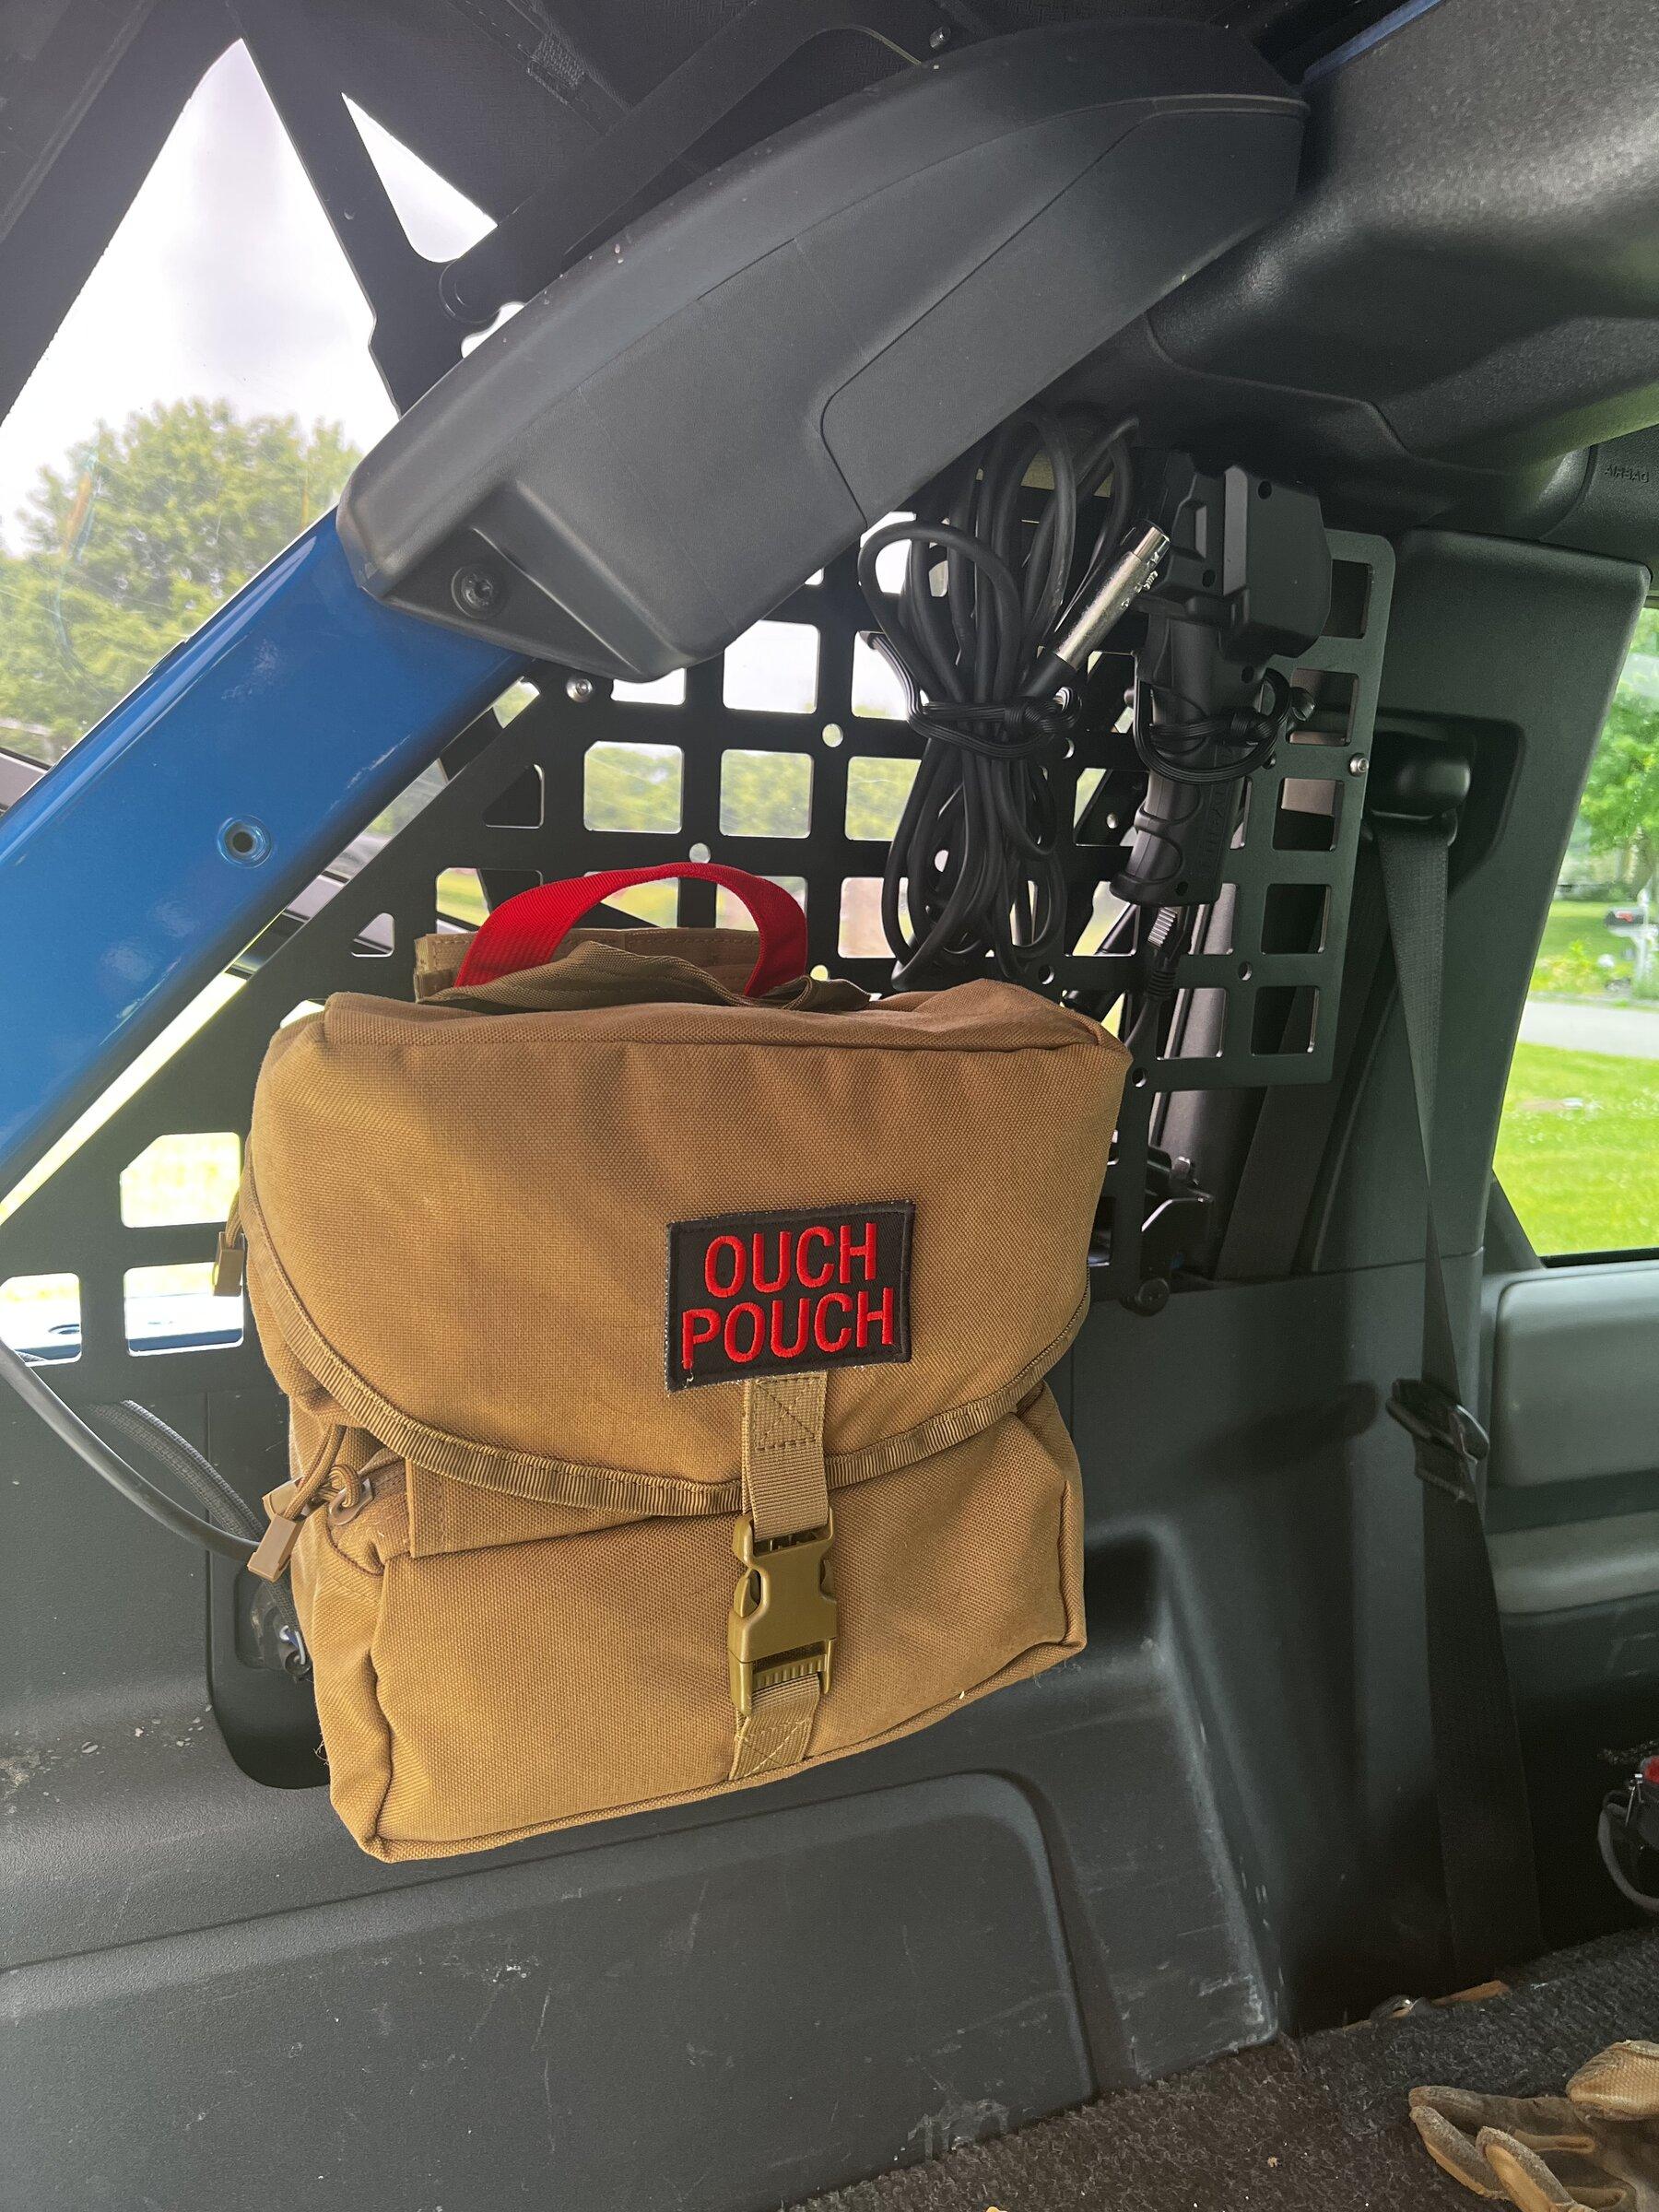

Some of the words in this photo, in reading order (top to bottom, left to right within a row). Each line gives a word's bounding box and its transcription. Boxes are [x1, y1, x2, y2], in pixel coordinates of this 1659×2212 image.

[1604, 464, 1650, 484] AIRBAG
[704, 1222, 877, 1299] OUCH
[681, 1288, 894, 1371] POUCH
